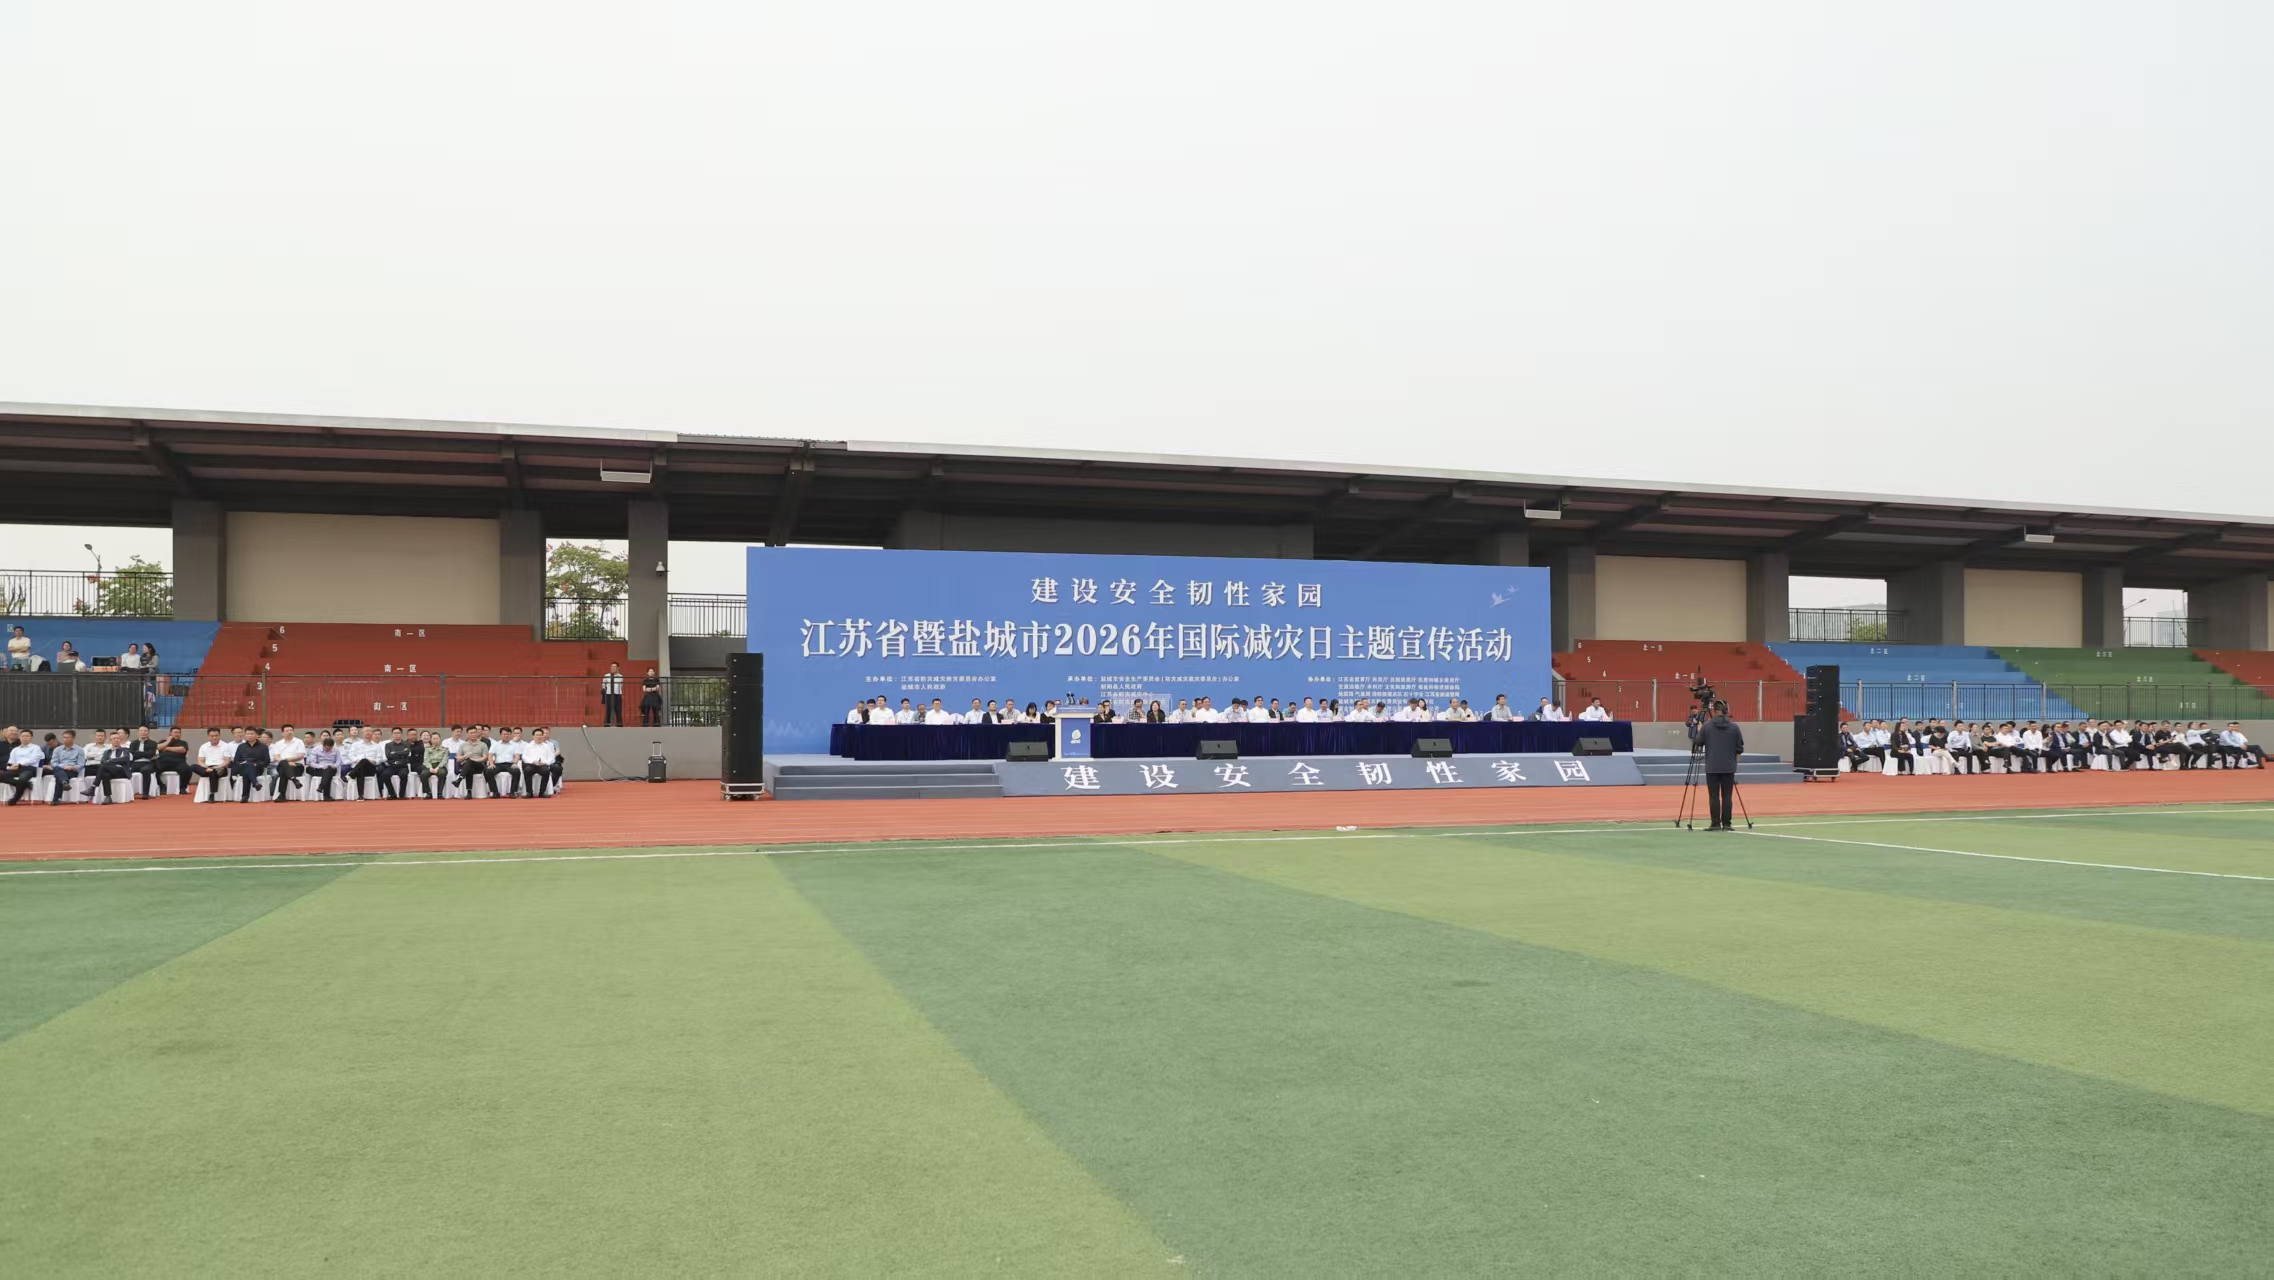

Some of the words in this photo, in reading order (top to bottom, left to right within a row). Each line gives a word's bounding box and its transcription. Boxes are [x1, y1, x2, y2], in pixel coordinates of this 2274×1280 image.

[1031, 577, 1322, 608] 建设安全韧性家园
[279, 626, 285, 634] 6
[394, 629, 425, 638] 南一区
[800, 618, 1513, 662] 江苏省暨盐城市2026年国际减灾日主题宣传活动
[272, 644, 278, 652] 5
[265, 662, 270, 670] 4
[384, 664, 416, 672] 南一区
[256, 682, 262, 690] 3
[248, 701, 254, 710] 2
[1060, 760, 1591, 790] 建设安全韧性家园
